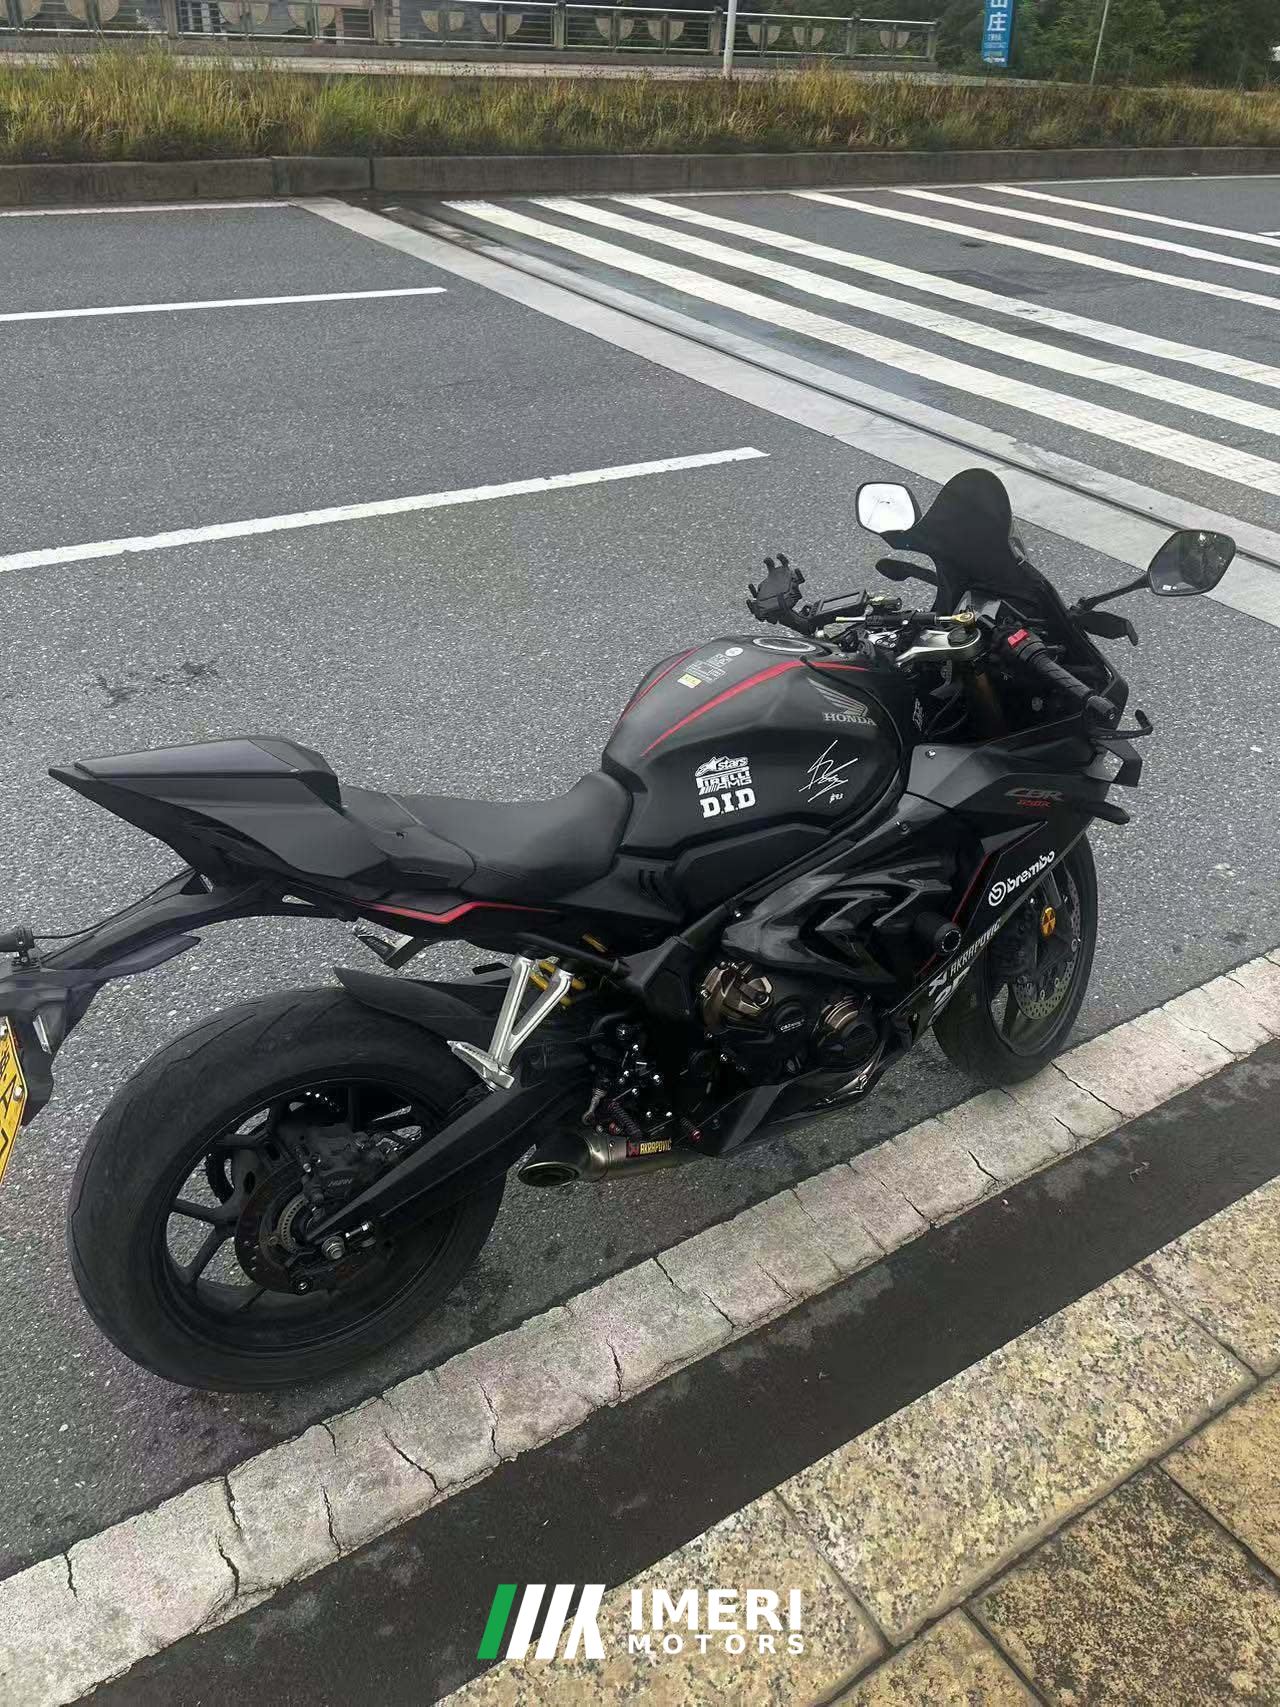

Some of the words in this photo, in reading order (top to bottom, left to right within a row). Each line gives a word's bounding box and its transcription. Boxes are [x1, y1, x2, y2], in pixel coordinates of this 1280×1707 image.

[823, 712, 877, 727] HONDA
[716, 757, 749, 771] stars
[699, 787, 756, 818] D.I.D
[1006, 850, 1055, 894] brembo
